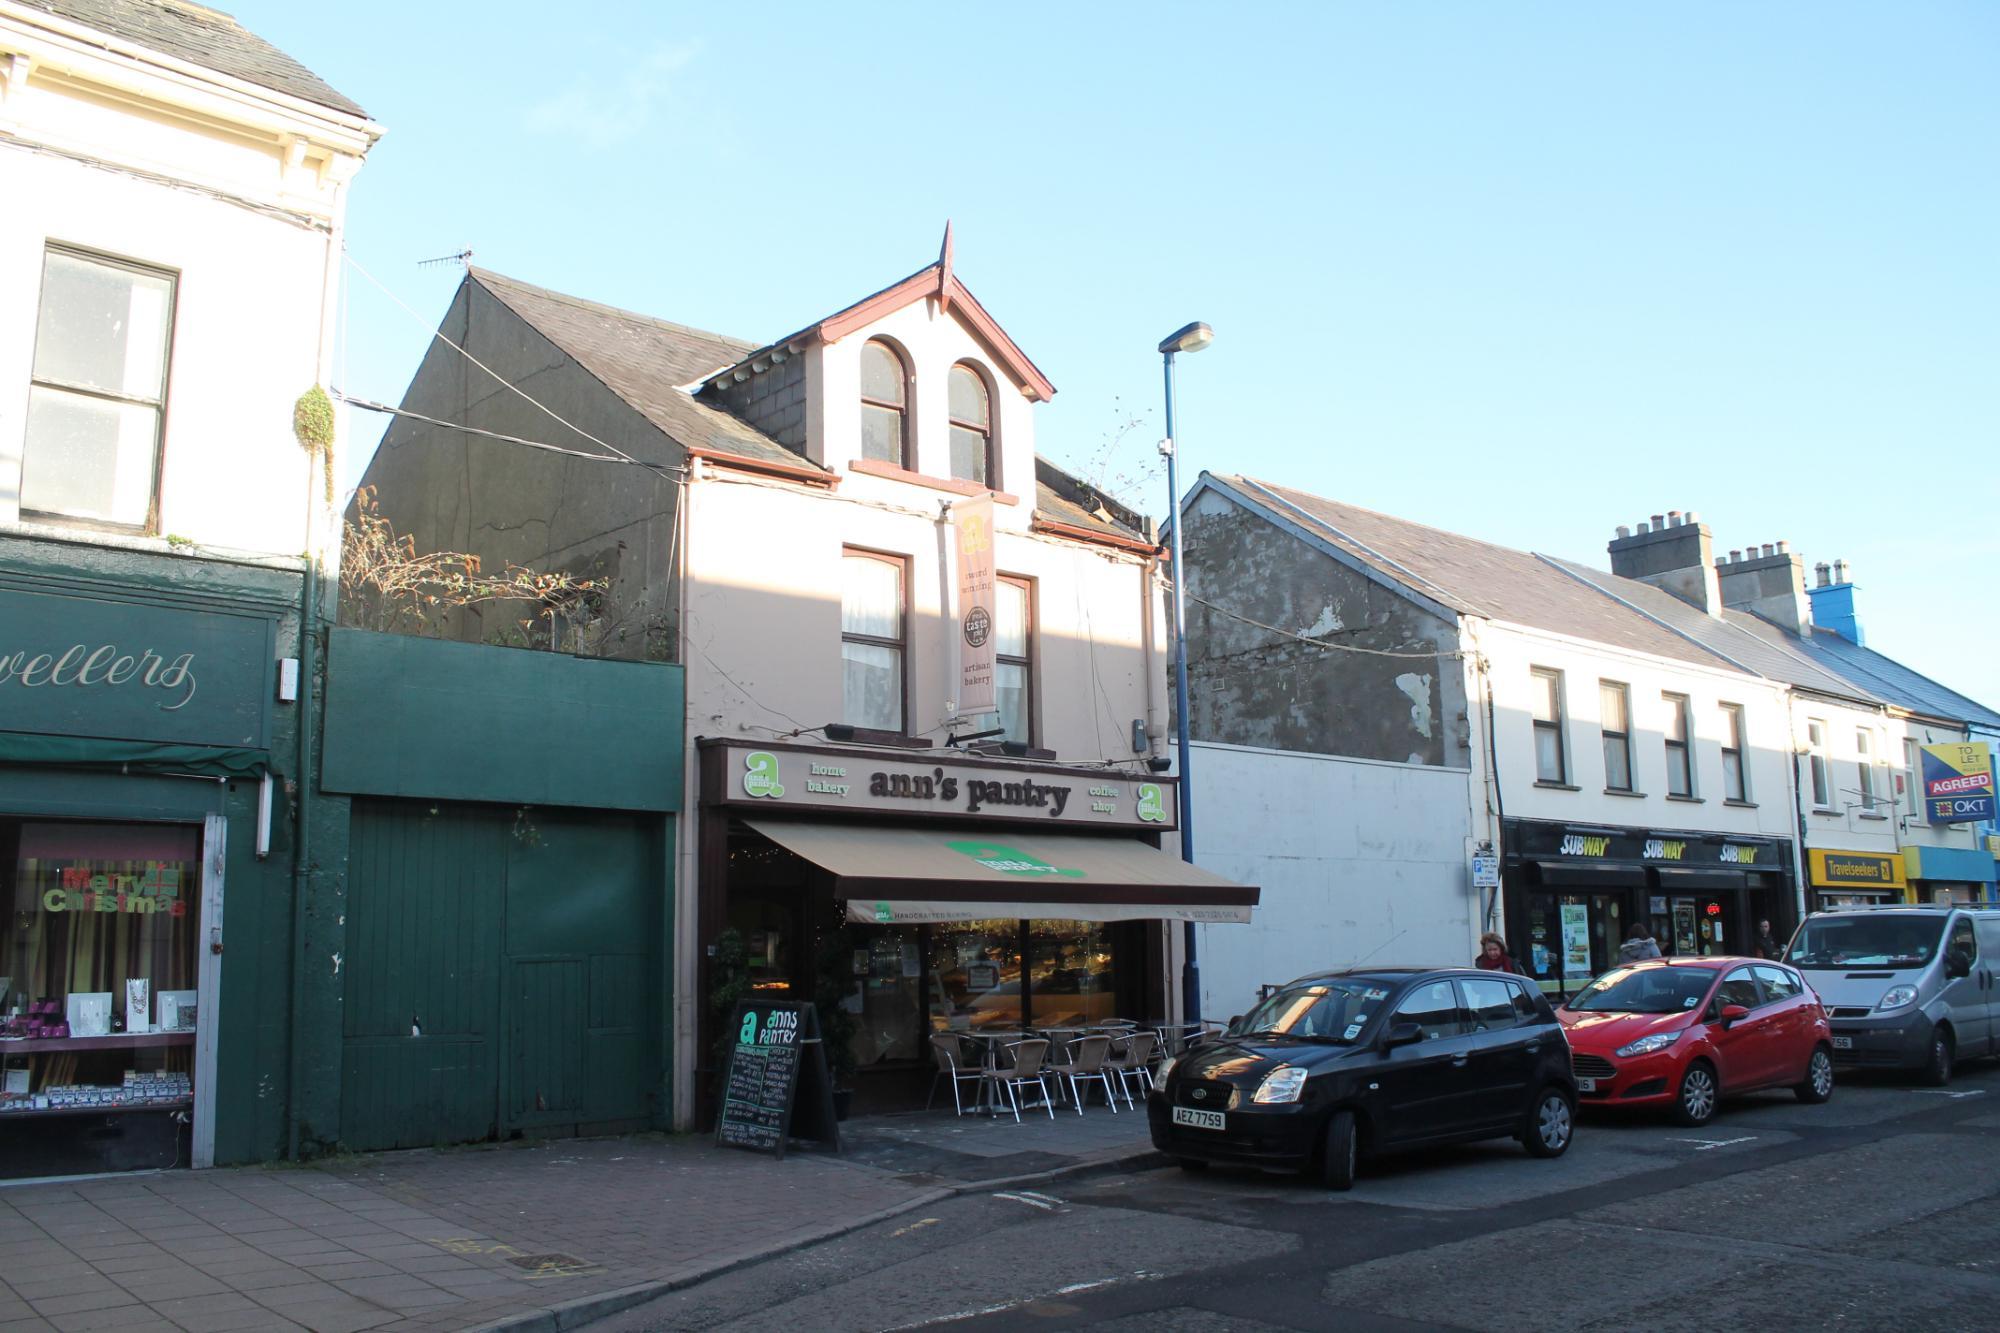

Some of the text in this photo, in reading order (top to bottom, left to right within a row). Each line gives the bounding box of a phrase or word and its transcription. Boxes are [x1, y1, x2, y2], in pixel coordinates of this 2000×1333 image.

[964, 662, 990, 673] artisan
[964, 674, 990, 686] bakery
[1957, 746, 1973, 755] TO
[1961, 754, 1980, 764] LET
[811, 762, 848, 777] home
[806, 779, 851, 797] bakery
[870, 767, 1071, 817] ann's pantry
[1089, 784, 1119, 798] coffee
[1933, 775, 1988, 793] AGREED
[1092, 800, 1117, 815] shop
[1954, 799, 1987, 812] OKT
[1560, 834, 1609, 857] SUBWAY
[1643, 839, 1685, 860] SUBWAY
[1719, 844, 1757, 864] SUBWAY
[1828, 860, 1879, 877] Travelseekers
[63, 867, 146, 897] Merry
[43, 888, 187, 917] Christmas
[767, 1010, 797, 1029] anns
[1195, 1111, 1221, 1126] 7759
